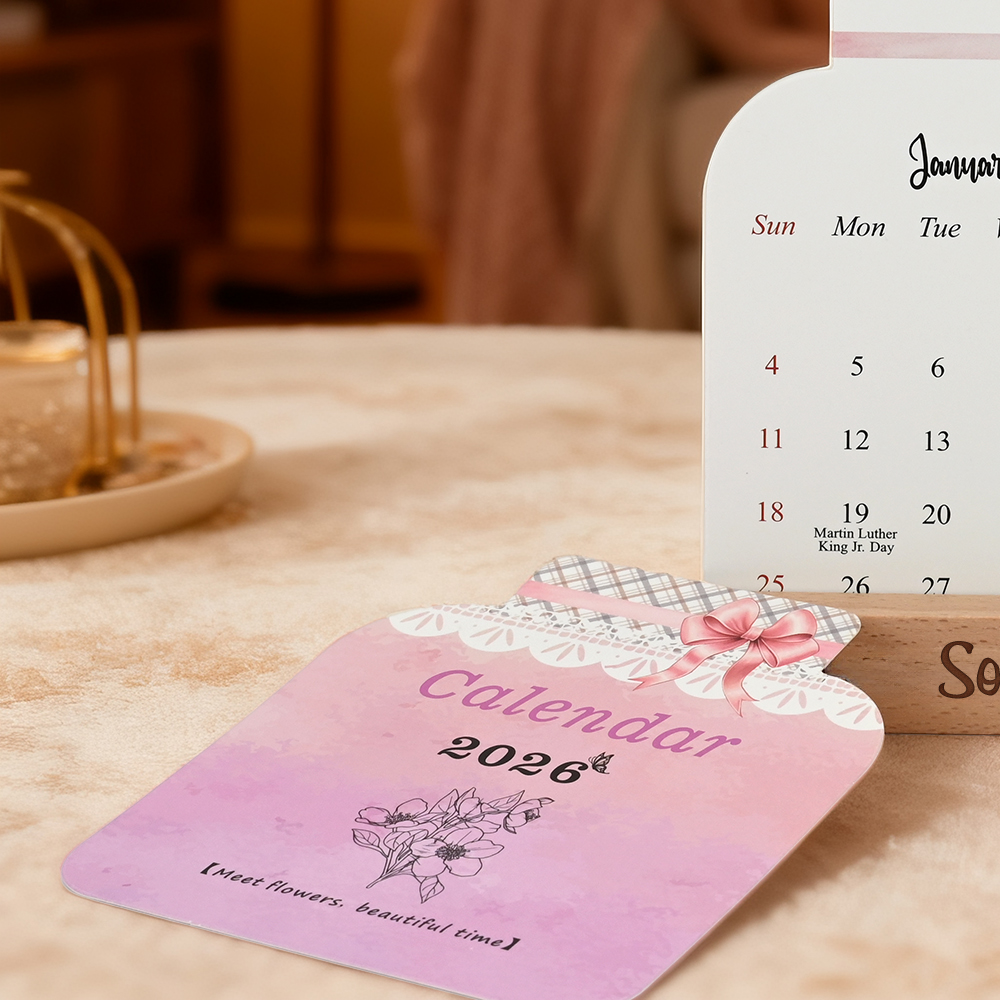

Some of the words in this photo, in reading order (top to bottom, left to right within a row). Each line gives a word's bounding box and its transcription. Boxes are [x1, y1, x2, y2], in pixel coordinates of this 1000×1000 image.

[751, 213, 796, 236] Sun
[831, 215, 886, 237] Mon
[919, 216, 962, 239] Tue
[764, 354, 780, 376] 4
[850, 355, 864, 377] 5
[930, 356, 945, 379] 6
[760, 427, 783, 449] 11
[843, 429, 870, 451] 12
[924, 430, 950, 452] 13
[758, 501, 784, 523] 18
[842, 502, 870, 525] 19
[921, 503, 952, 526] 20
[813, 526, 855, 539] Martin
[858, 527, 899, 540] Luther
[818, 540, 849, 556] King
[851, 540, 865, 553] Jr.
[869, 540, 895, 556] Day
[756, 573, 785, 592] 25
[841, 575, 870, 594] 26
[921, 576, 951, 595] 27
[419, 669, 742, 758] Calendar
[437, 736, 588, 784] 2026
[355, 902, 452, 934] beautiful
